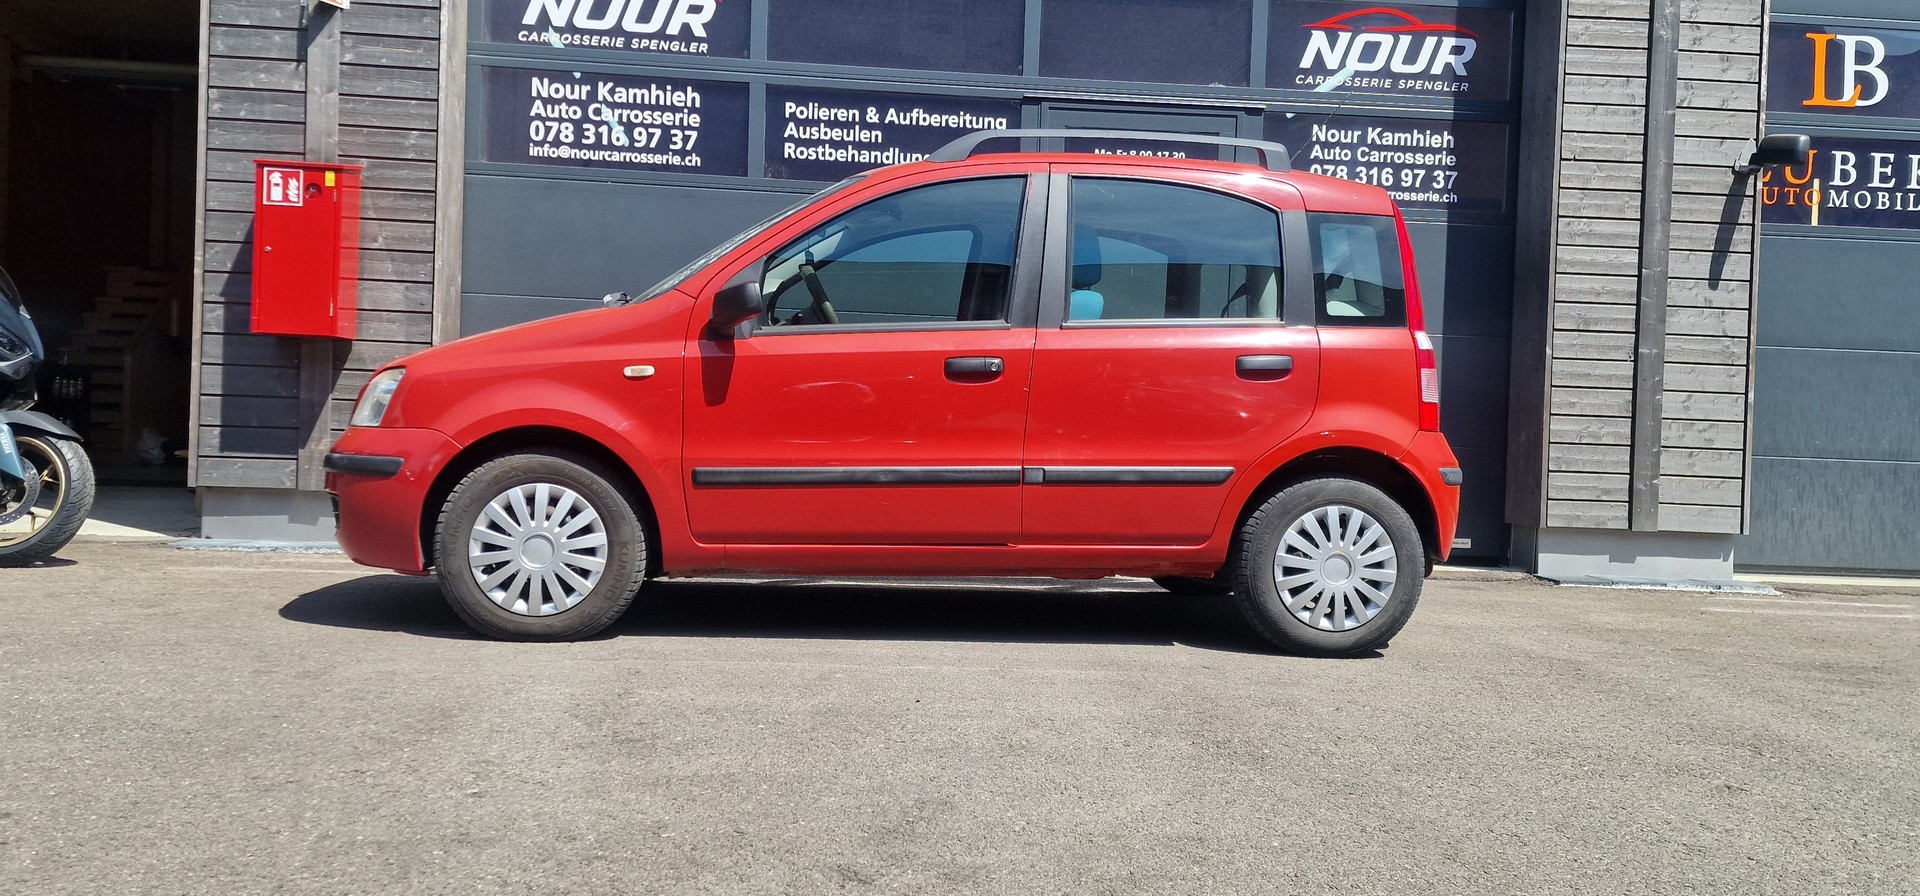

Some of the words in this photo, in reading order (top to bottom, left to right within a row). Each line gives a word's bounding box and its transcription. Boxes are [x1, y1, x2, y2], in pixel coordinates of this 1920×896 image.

[521, 0, 717, 38] NOUR
[518, 31, 625, 48] CARROSSERIE
[630, 37, 709, 54] SPENGLER
[1299, 30, 1477, 76] NOUR
[1295, 74, 1393, 89] CARROSSERIE
[1398, 79, 1469, 92] SPENGLER
[1803, 33, 1889, 107] LB
[531, 76, 591, 101] Nour
[597, 81, 701, 108] Kamhieh
[529, 99, 582, 120] Auto
[587, 103, 701, 127] Carrosserie
[784, 102, 860, 122] Polieren
[865, 106, 880, 123] &
[884, 108, 1007, 130] Aufbereitung
[529, 120, 575, 143] 078
[581, 123, 625, 147] 316
[633, 127, 662, 149] 97
[669, 129, 698, 151] 37
[783, 122, 882, 143] Ausbeulen
[1312, 124, 1361, 143] Nour
[1367, 127, 1455, 149] Kamhieh
[529, 142, 701, 167] info@nourcarrosserie.ch
[1310, 144, 1352, 161] Auto
[1356, 146, 1457, 166] Carrosserie
[1355, 166, 1394, 187] 316
[1401, 168, 1426, 188] 97
[1432, 170, 1458, 190] 37
[1386, 190, 1458, 203] rosserie.ch
[605, 540, 629, 600] KUMHO
